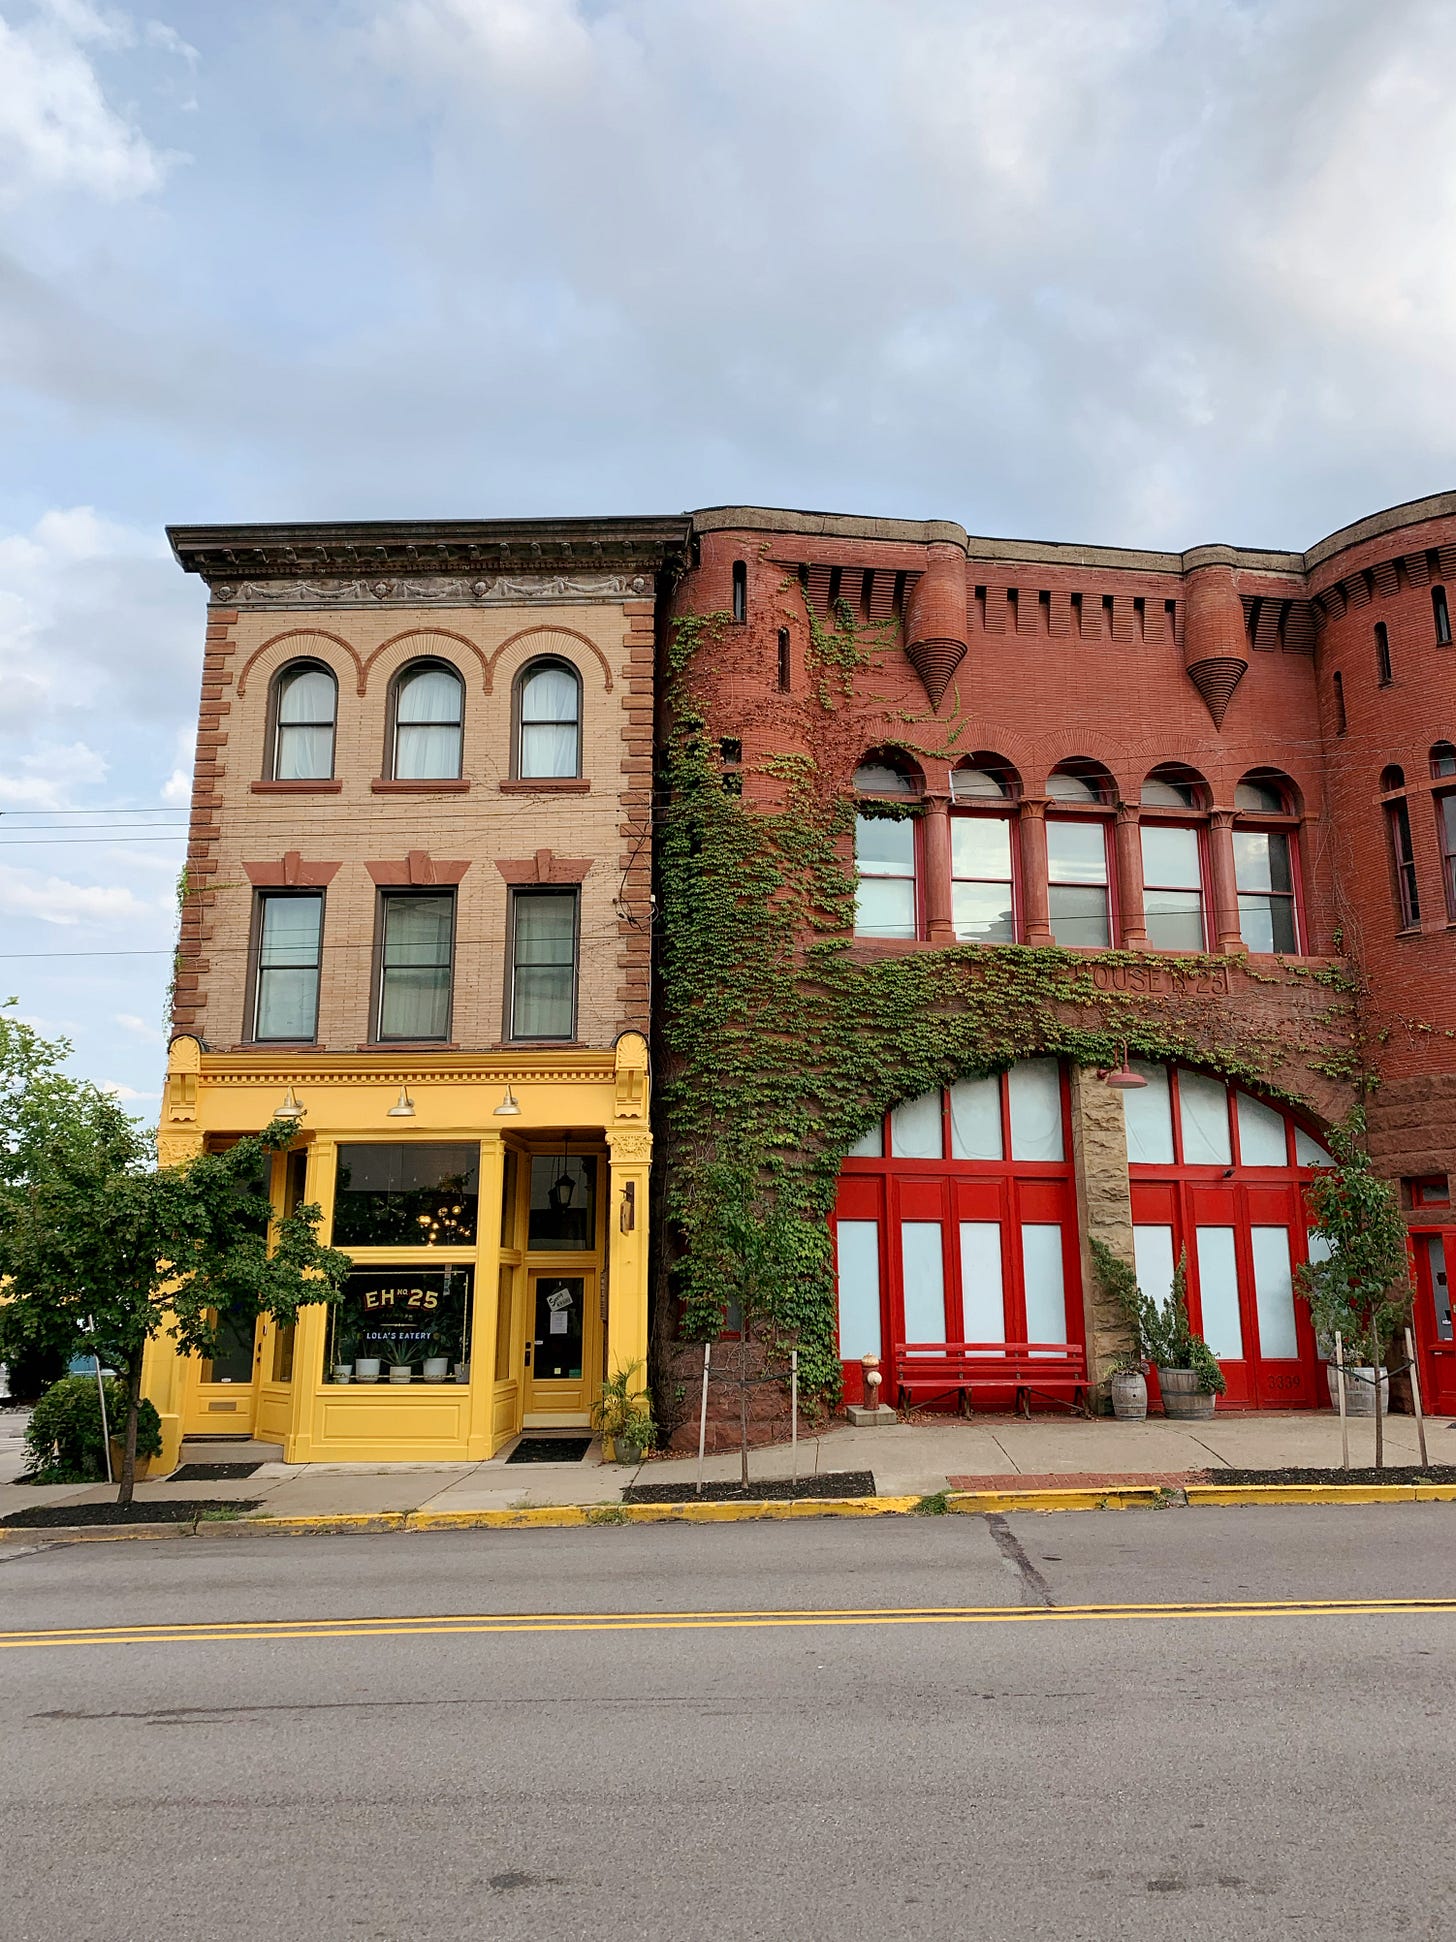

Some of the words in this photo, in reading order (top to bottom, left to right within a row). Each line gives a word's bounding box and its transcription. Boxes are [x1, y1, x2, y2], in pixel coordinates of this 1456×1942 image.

[364, 1289, 395, 1309] EH
[407, 1288, 439, 1310] 25
[366, 1332, 397, 1340] LOLA'S
[399, 1332, 432, 1340] EATERY
[1268, 1375, 1301, 1390] 3339
